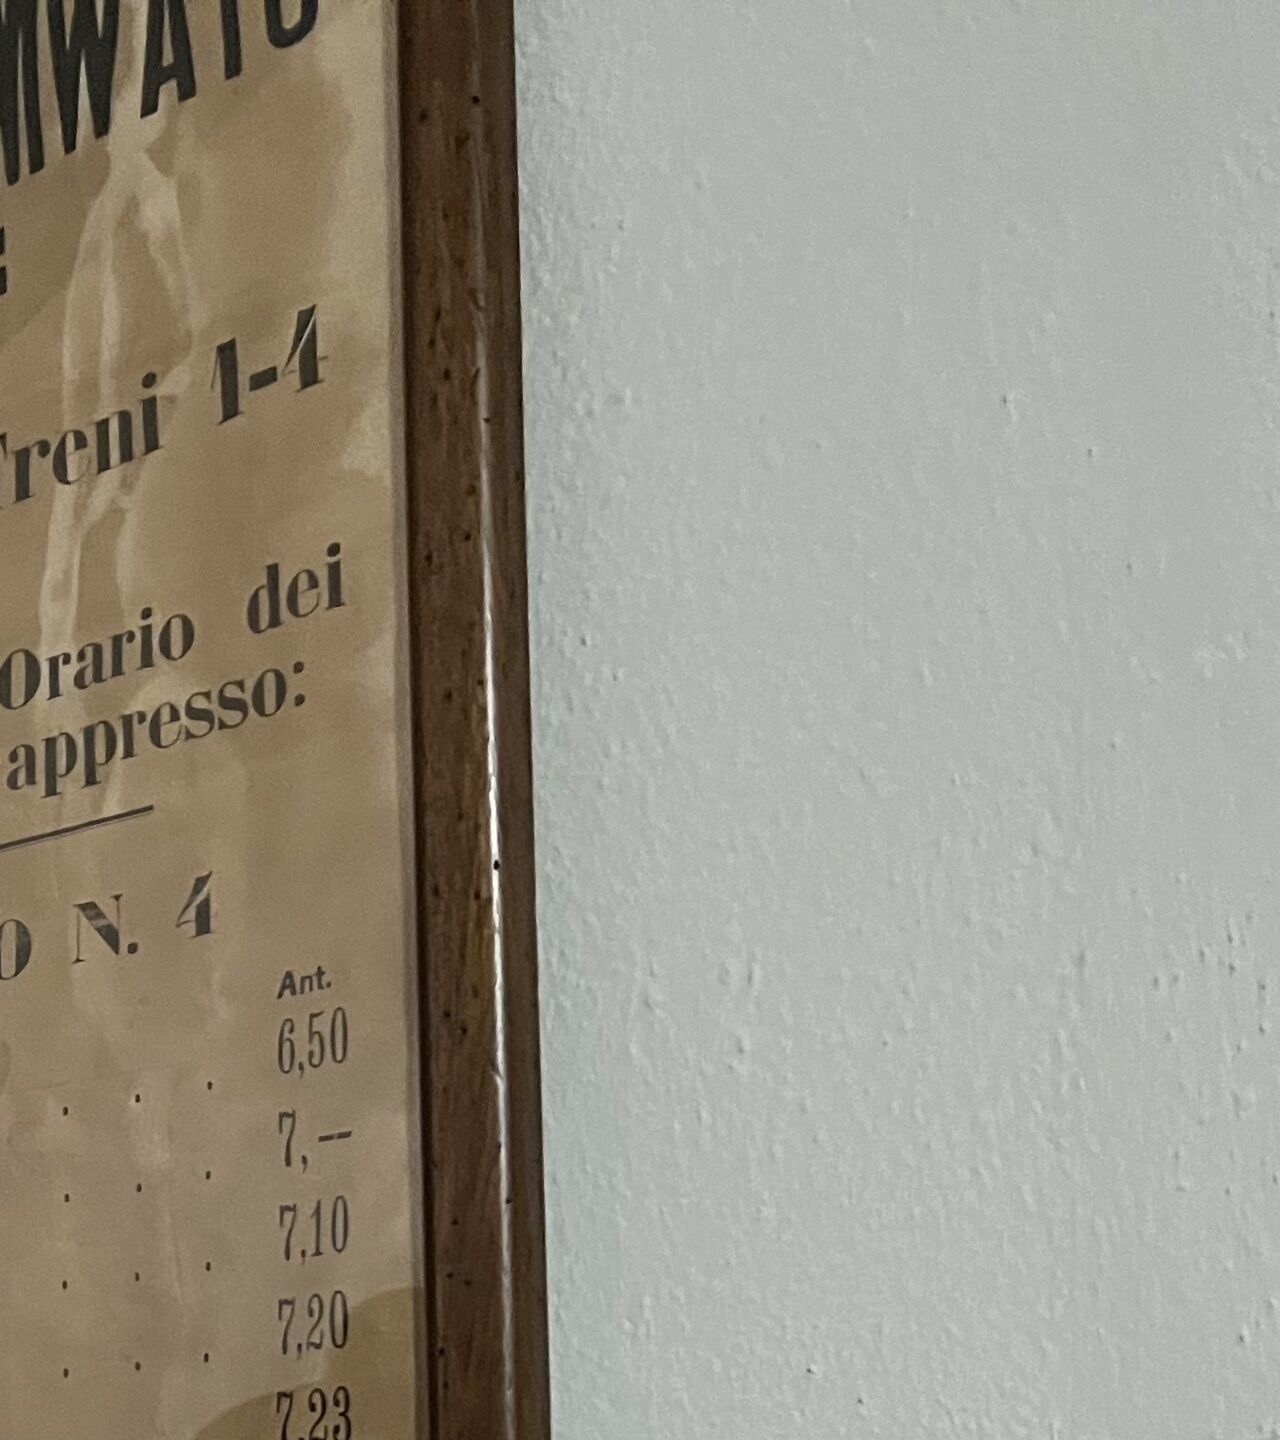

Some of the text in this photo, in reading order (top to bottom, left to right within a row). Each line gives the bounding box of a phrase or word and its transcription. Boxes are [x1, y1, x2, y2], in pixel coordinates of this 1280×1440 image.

[211, 303, 329, 426] 1-4
[246, 542, 348, 634] dei
[6, 660, 307, 799] appresso:
[72, 893, 139, 964] N.
[175, 870, 215, 939] 4
[276, 964, 333, 1000] Ant.
[277, 1005, 350, 1078] 6,50
[277, 1195, 351, 1264] 7,10
[276, 1290, 351, 1356] 7,20
